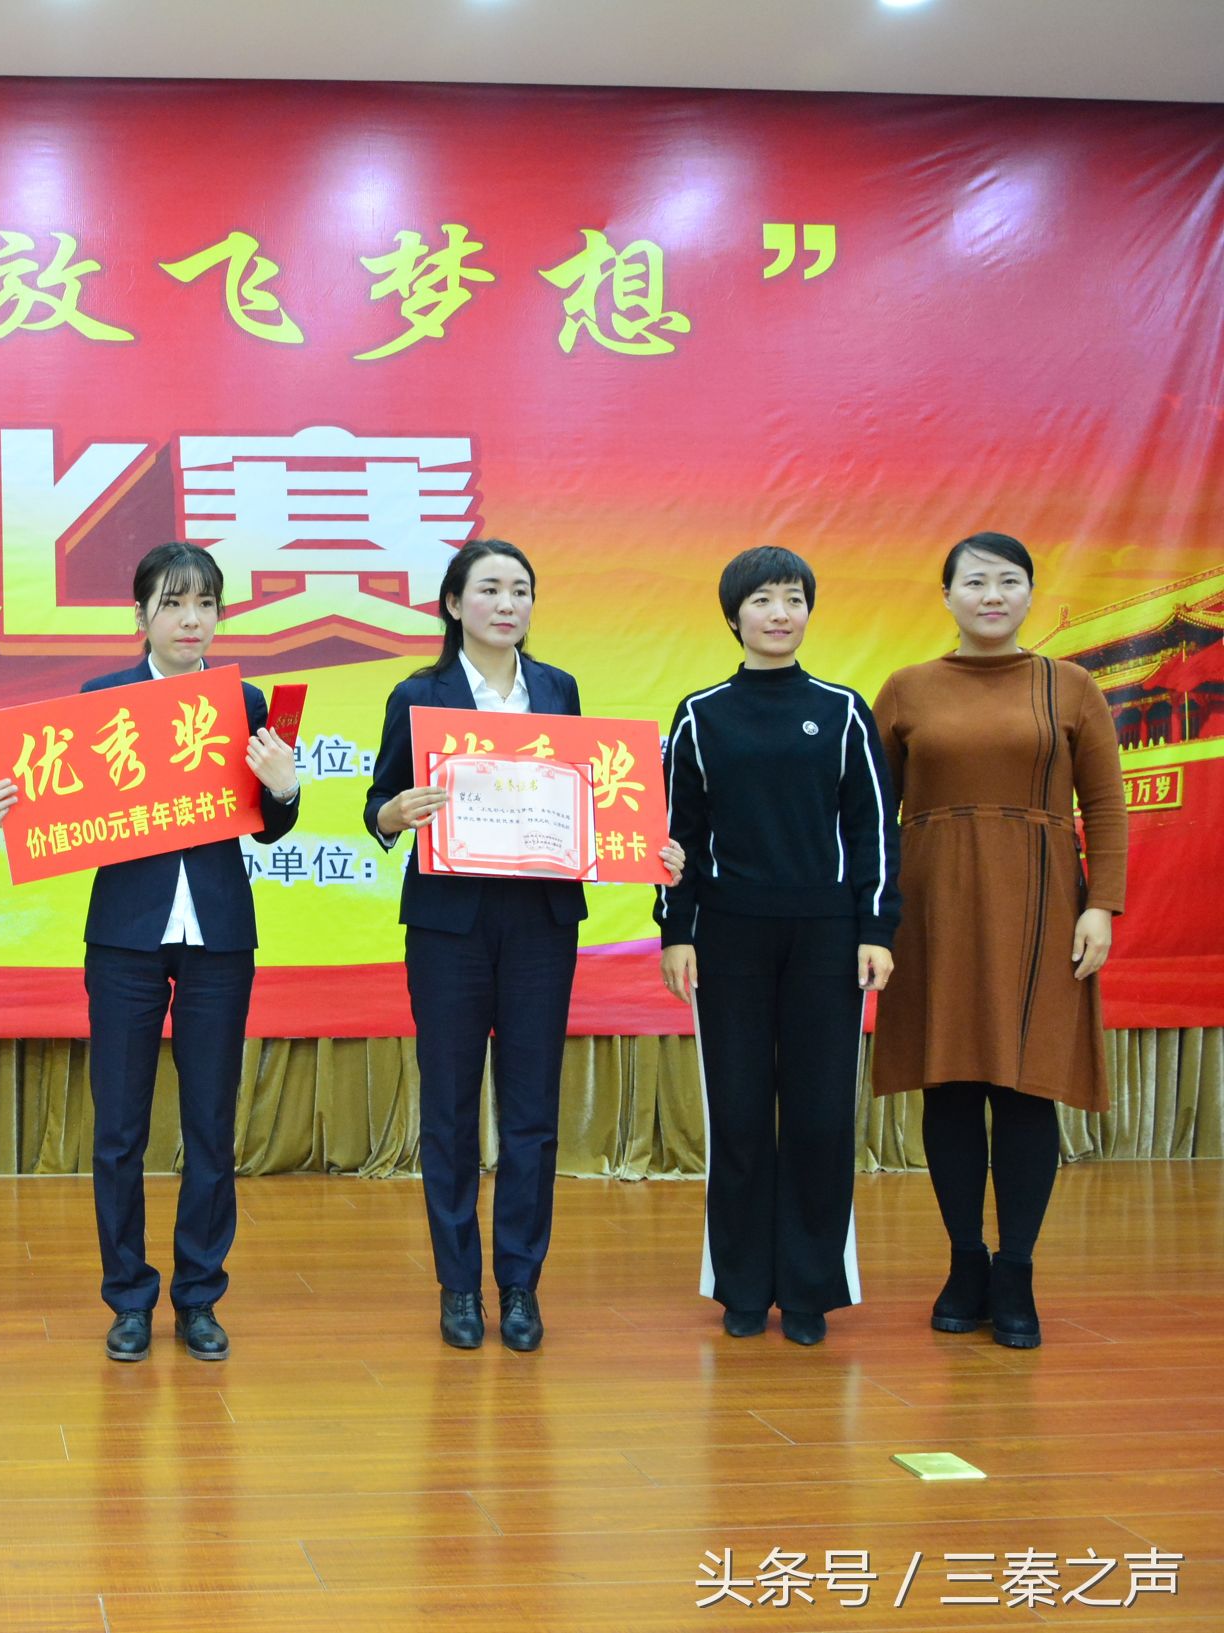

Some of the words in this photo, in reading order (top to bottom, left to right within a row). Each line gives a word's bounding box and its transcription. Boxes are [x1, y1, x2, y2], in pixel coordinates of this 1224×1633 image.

[12, 694, 231, 801] 优秀奖
[25, 787, 238, 859] 价值300元青年读书卡
